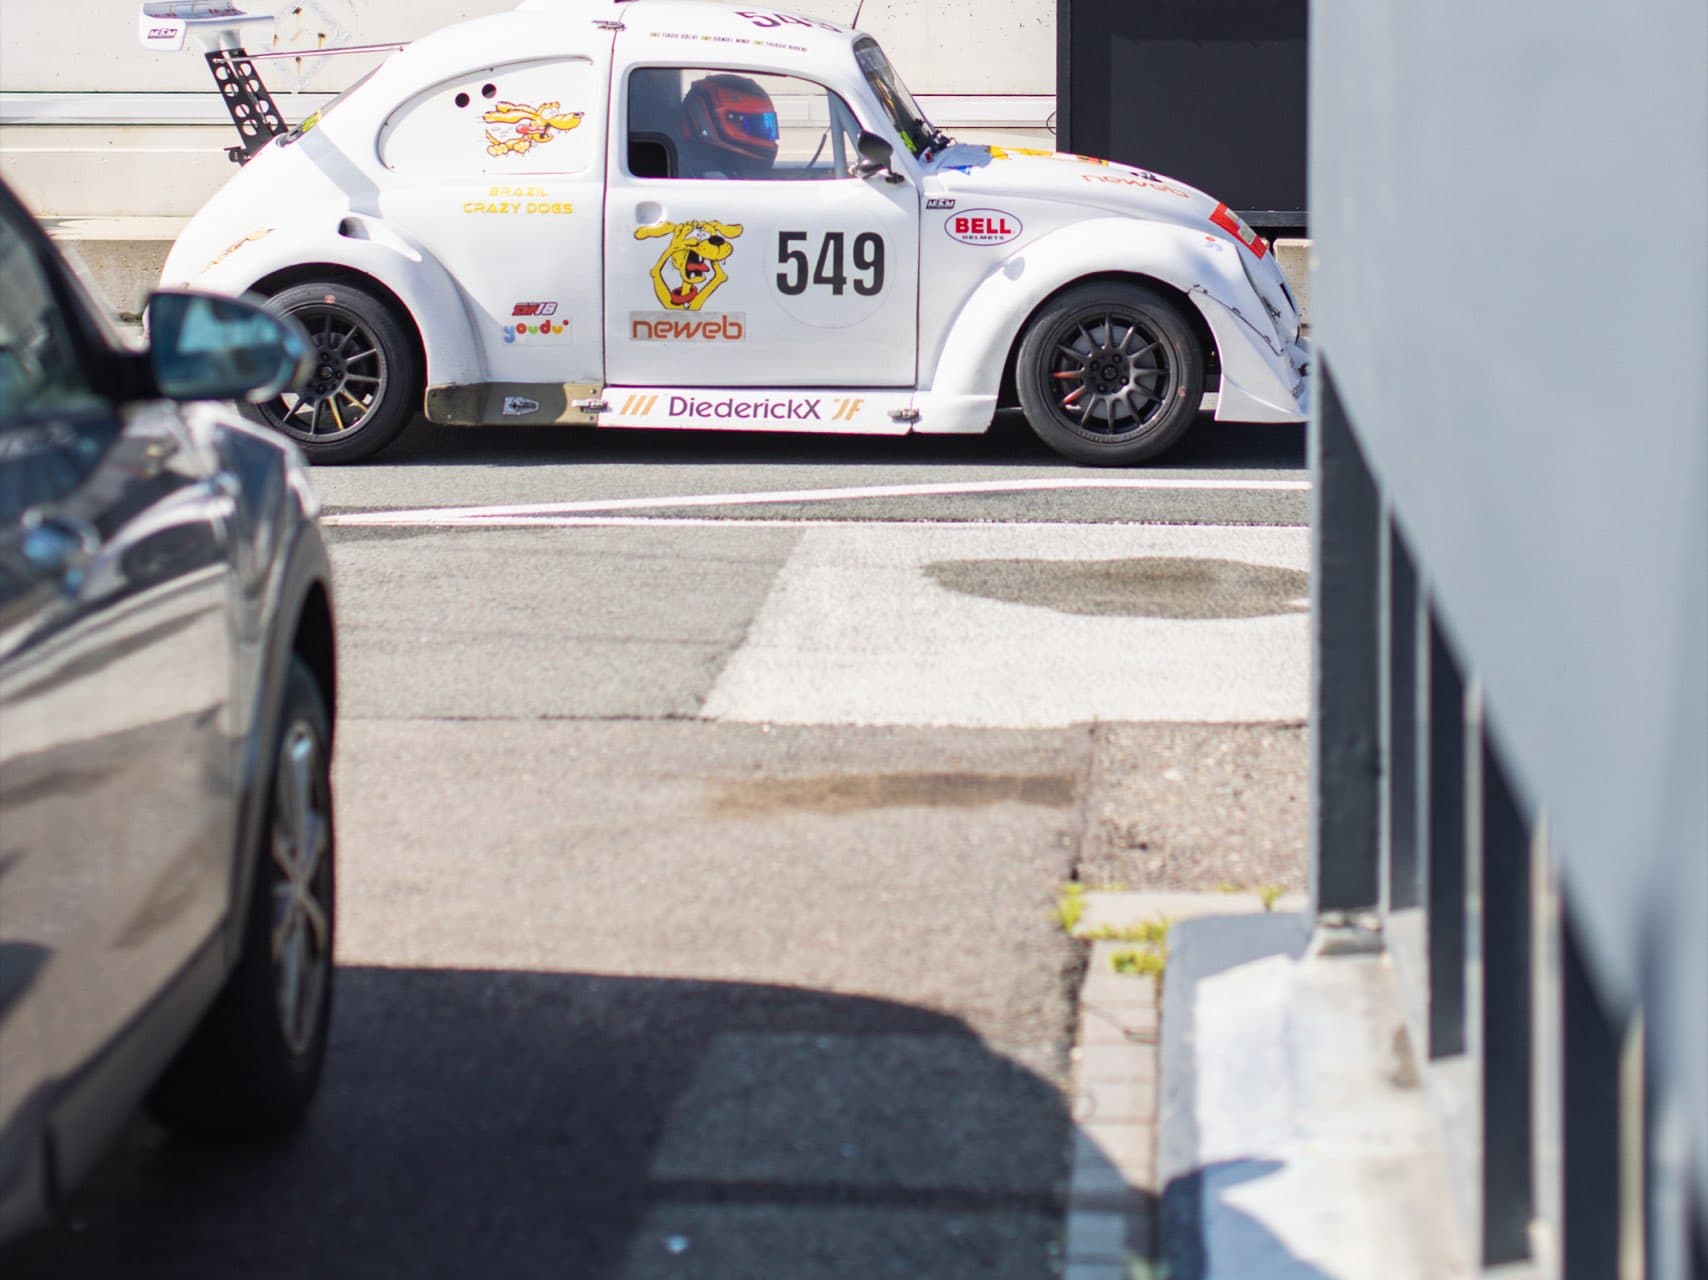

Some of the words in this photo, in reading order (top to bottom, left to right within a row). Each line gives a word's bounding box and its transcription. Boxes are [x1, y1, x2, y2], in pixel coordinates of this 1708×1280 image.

[463, 202, 521, 214] CRAZY
[526, 202, 574, 215] DOGS
[955, 218, 1012, 234] BELL
[776, 231, 885, 296] 549
[503, 319, 563, 344] youdu
[631, 314, 743, 340] neweb
[668, 396, 822, 420] DiederickX
